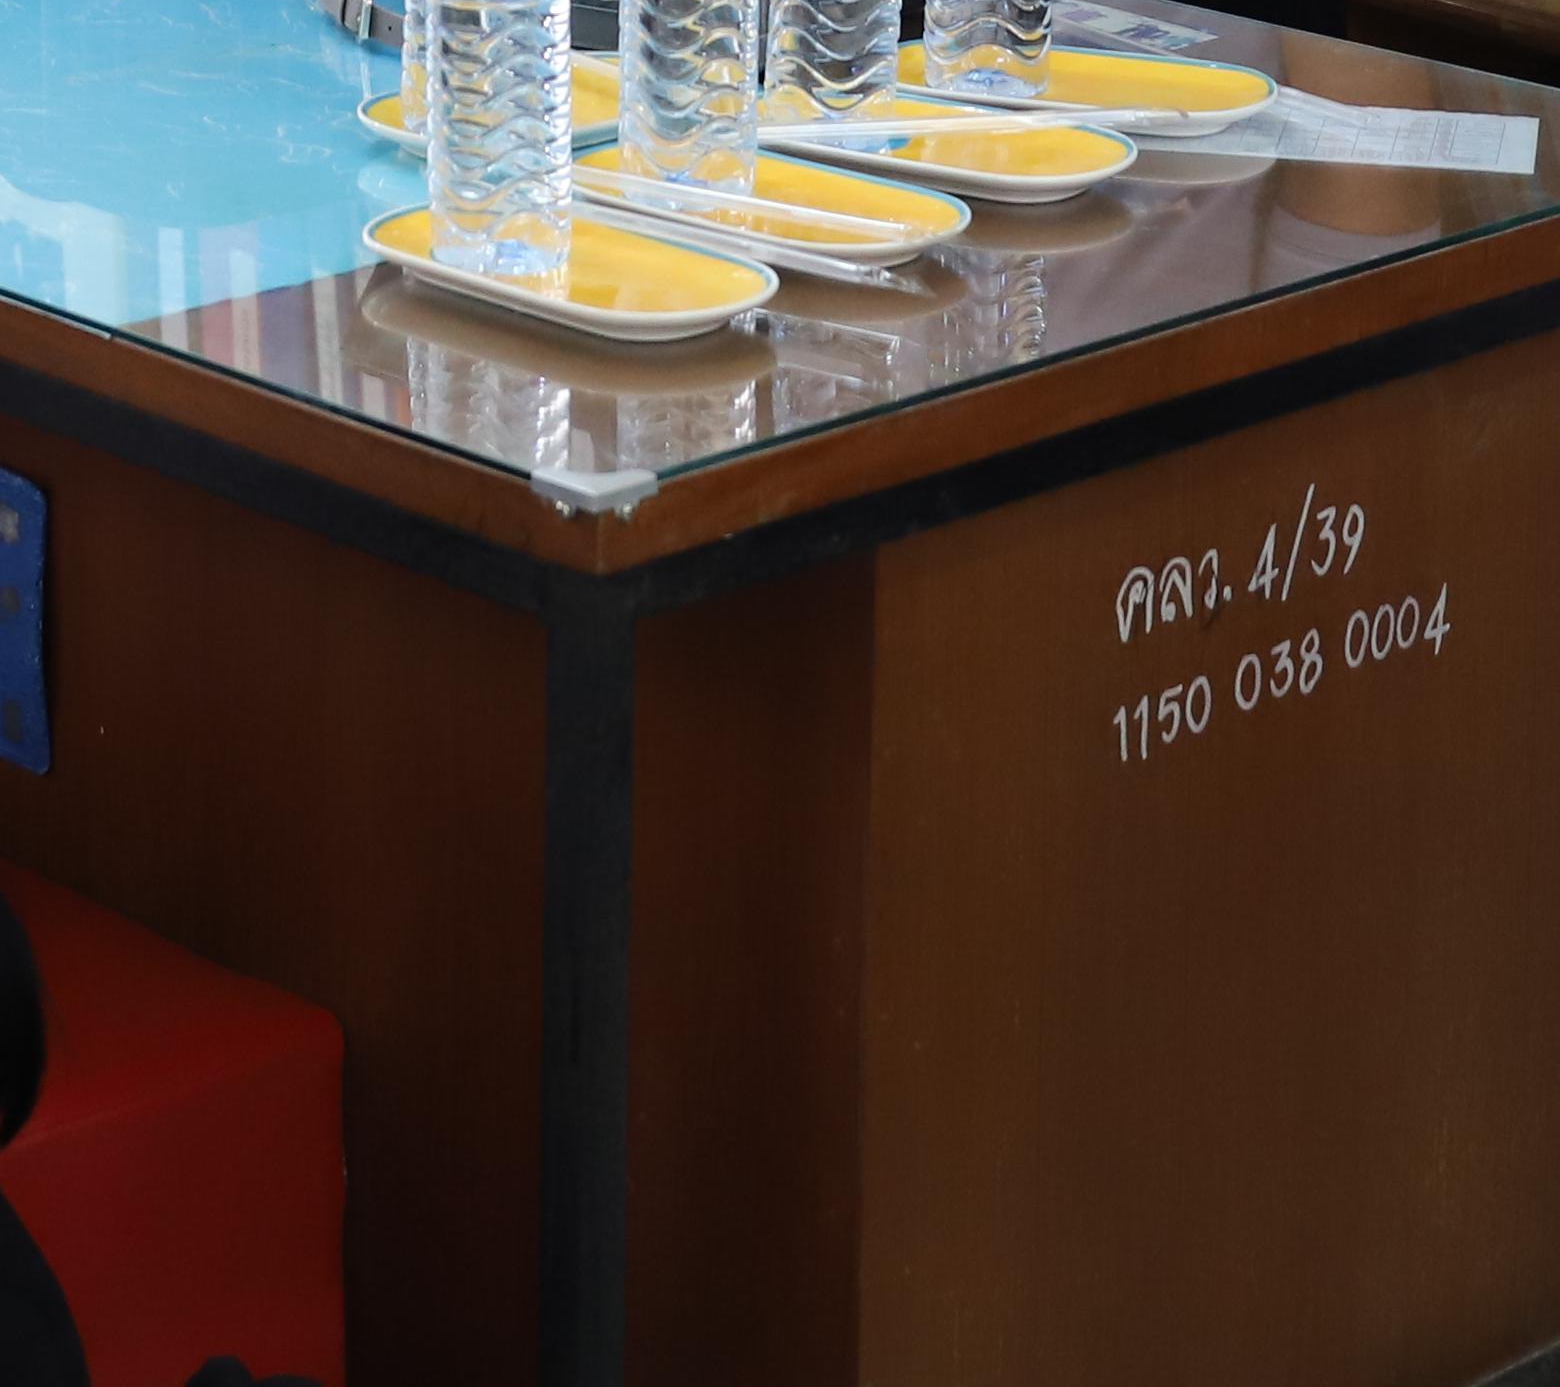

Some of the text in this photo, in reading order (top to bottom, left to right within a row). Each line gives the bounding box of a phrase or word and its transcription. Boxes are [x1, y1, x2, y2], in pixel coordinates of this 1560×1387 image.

[1248, 482, 1365, 602] 4/39
[1113, 582, 1451, 764] 1150 038 0004
